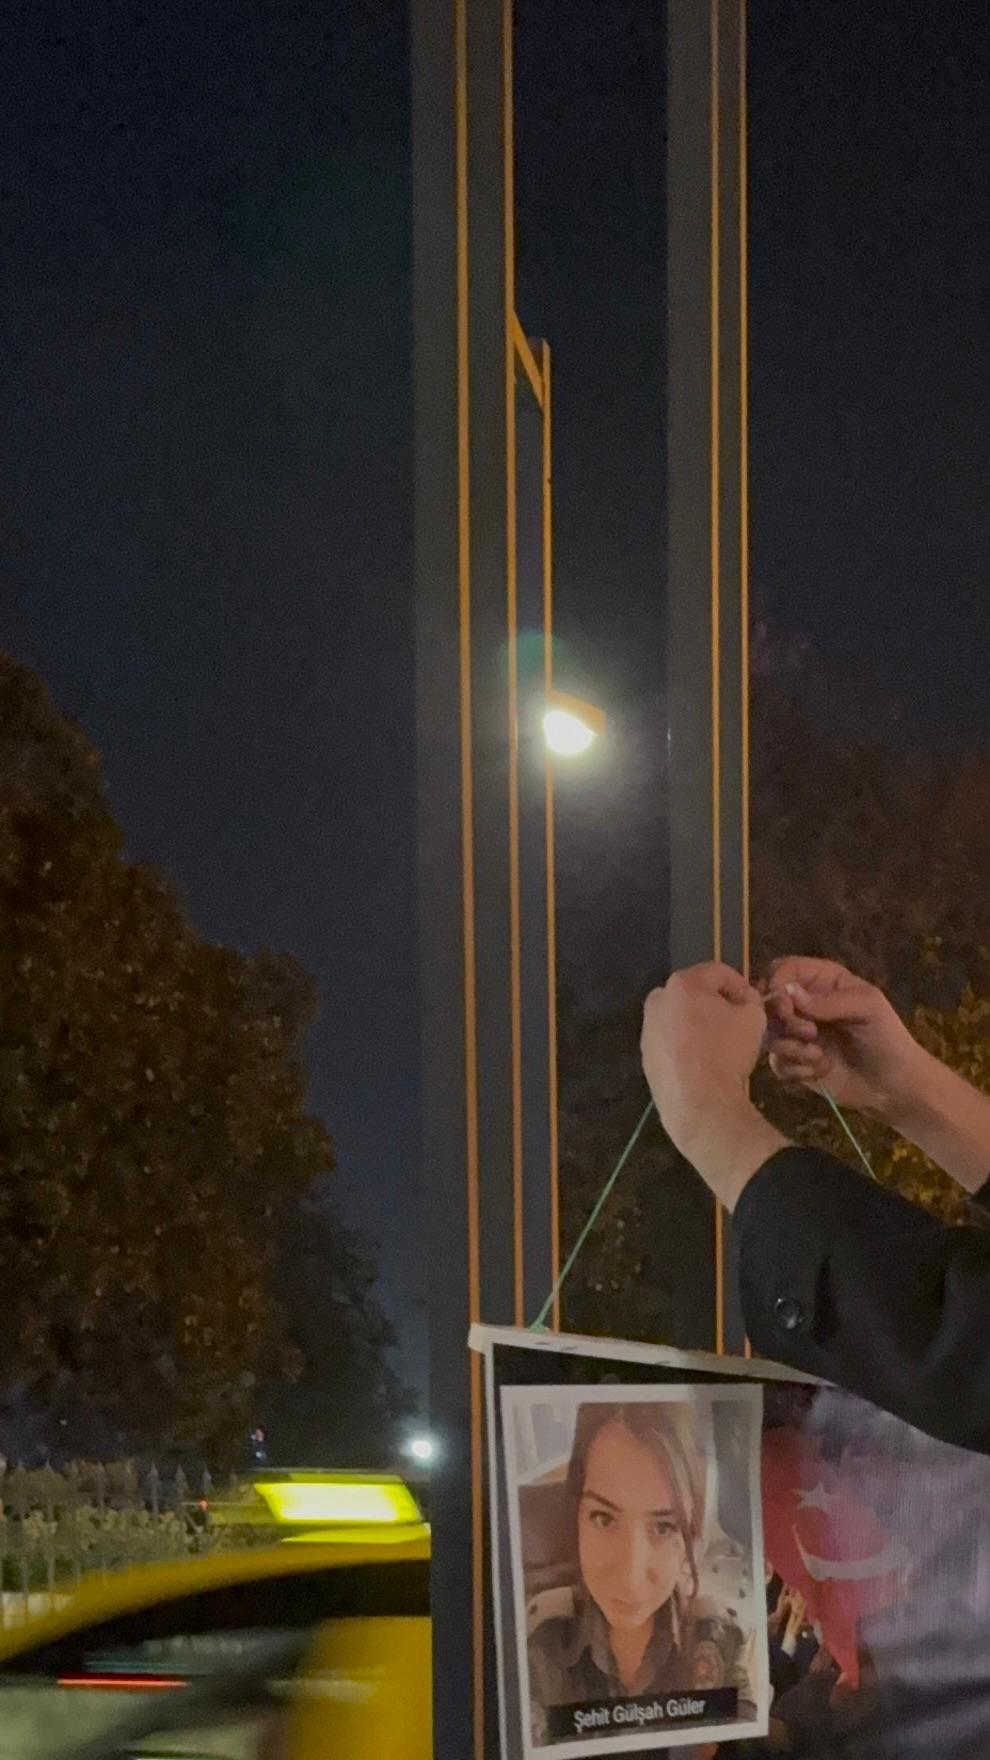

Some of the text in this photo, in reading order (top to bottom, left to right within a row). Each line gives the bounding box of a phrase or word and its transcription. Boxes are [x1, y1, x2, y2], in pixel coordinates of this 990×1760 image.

[574, 1698, 706, 1734] Şehit Gülşah Güler
